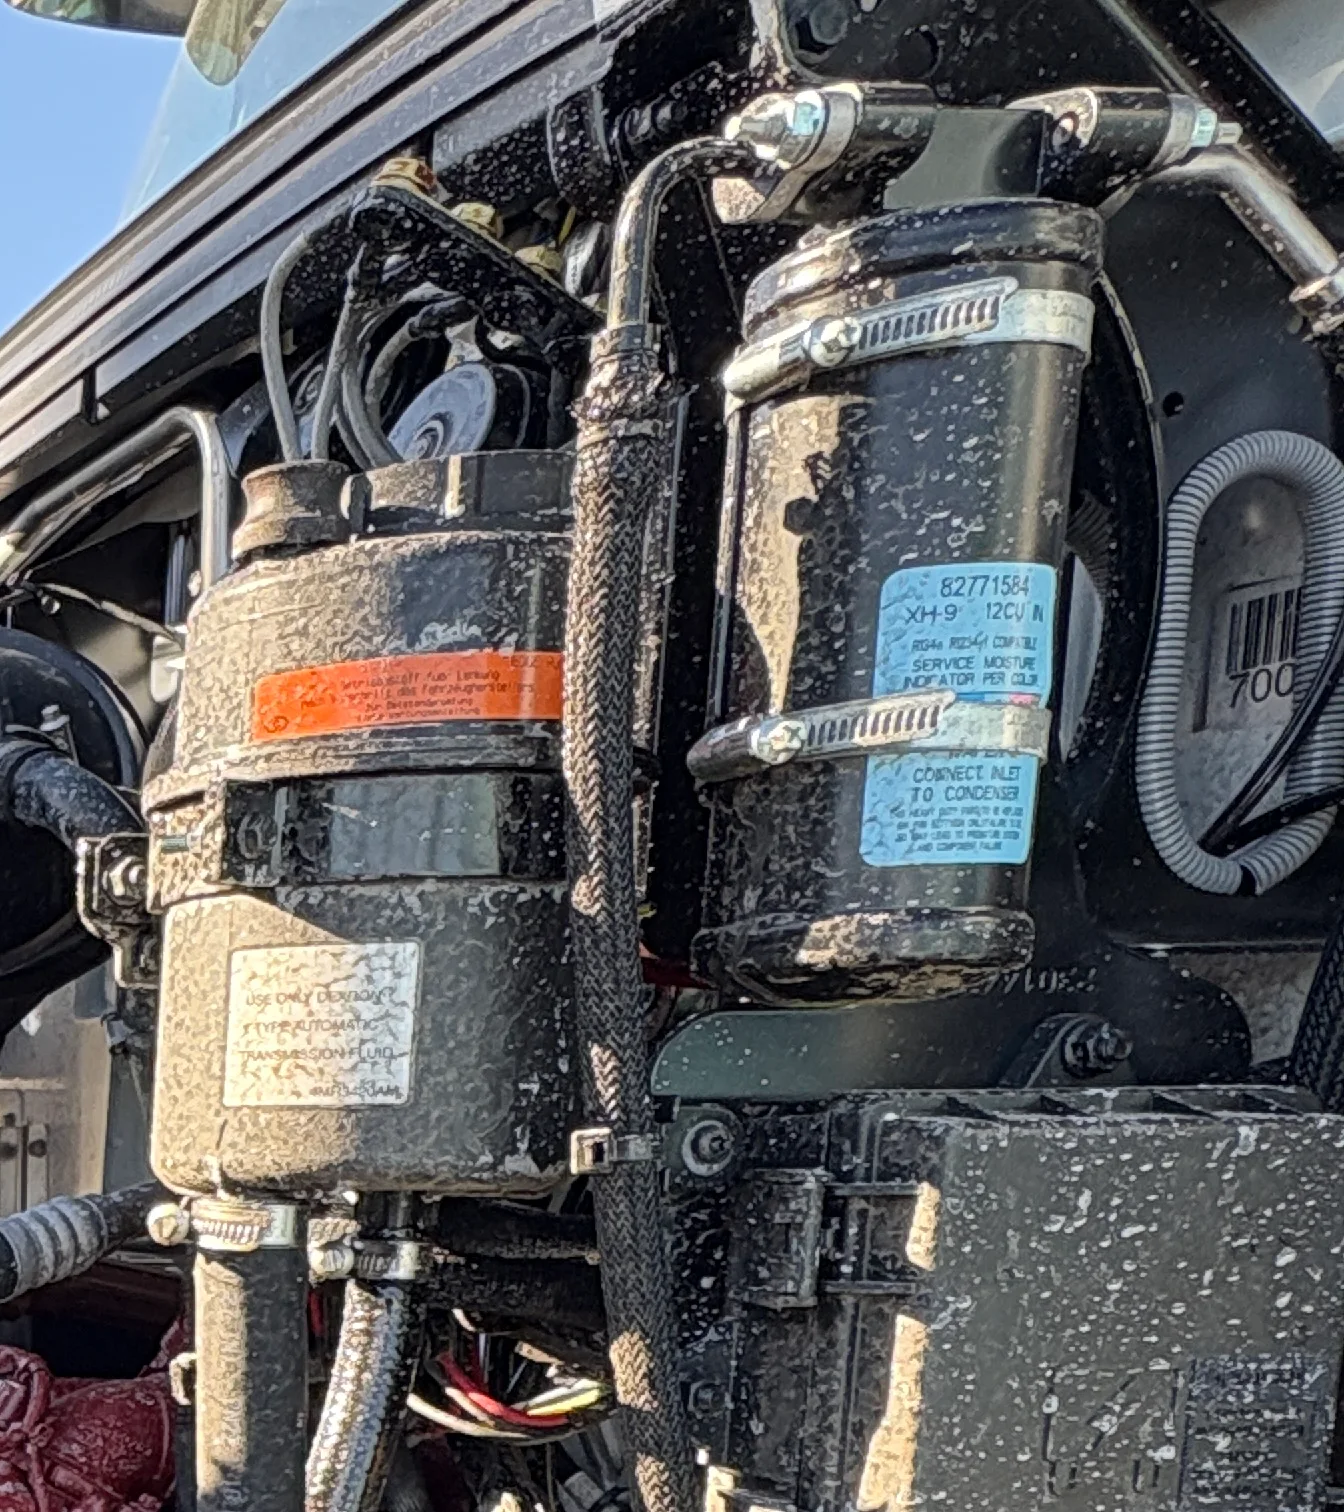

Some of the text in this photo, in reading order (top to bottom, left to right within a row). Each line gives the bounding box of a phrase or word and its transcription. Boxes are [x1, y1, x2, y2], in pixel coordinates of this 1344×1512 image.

[940, 575, 1030, 598] 82771584
[905, 604, 958, 624] XH-9
[913, 656, 975, 672] SERVICE
